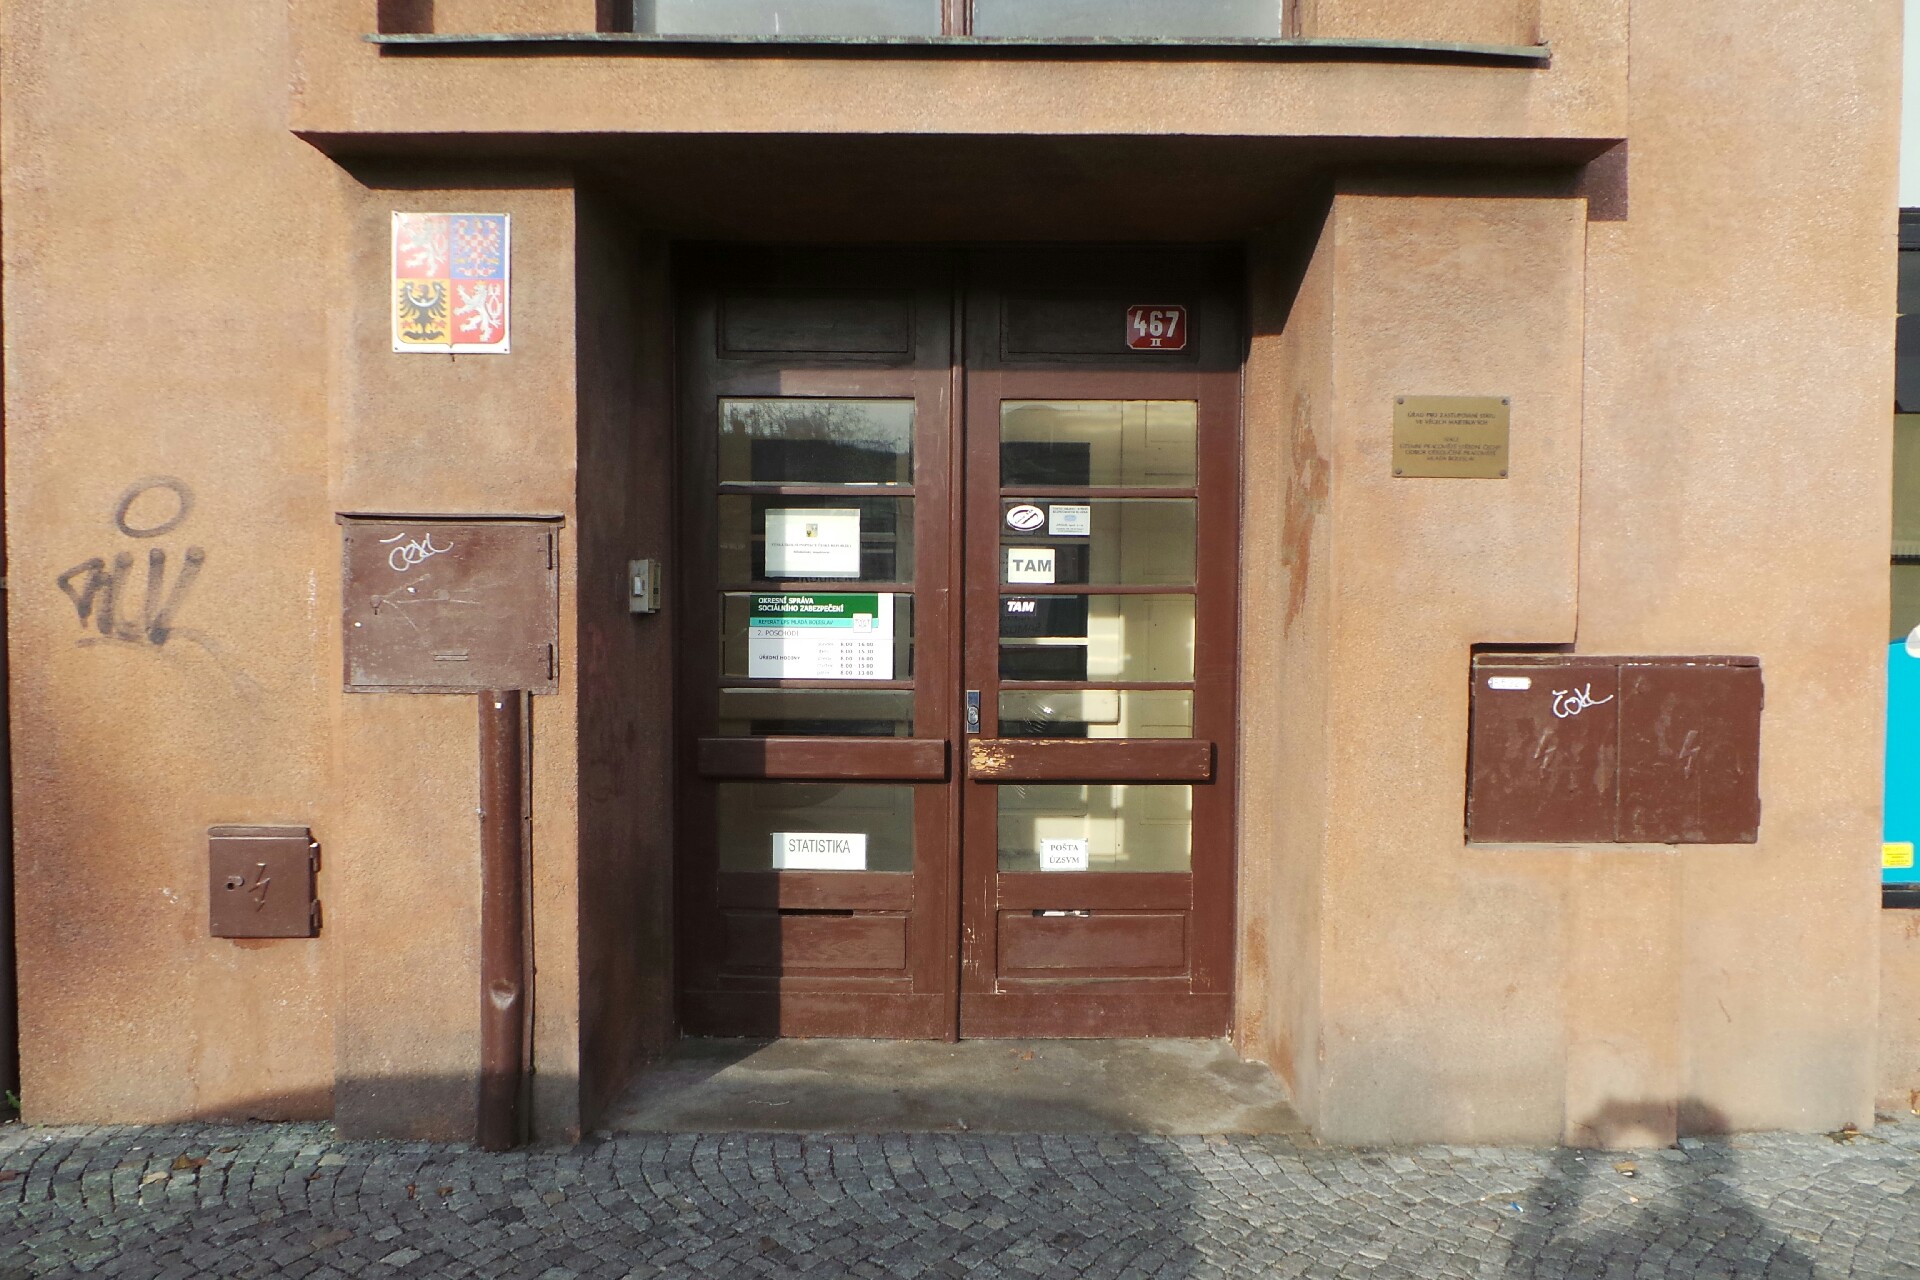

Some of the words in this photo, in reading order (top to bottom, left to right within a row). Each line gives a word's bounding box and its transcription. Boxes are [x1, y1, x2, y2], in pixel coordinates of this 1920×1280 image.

[1134, 310, 1179, 338] 467
[1150, 338, 1162, 346] II
[1013, 560, 1052, 572] TAM
[758, 596, 787, 604] OKRESNÍ
[788, 596, 814, 604] SPRÁVA
[800, 604, 844, 612] ZABEZPEČENÍ
[1007, 601, 1035, 612] TAM
[789, 839, 850, 853] STATISTIKA
[1050, 855, 1079, 863] ÚZSVM
